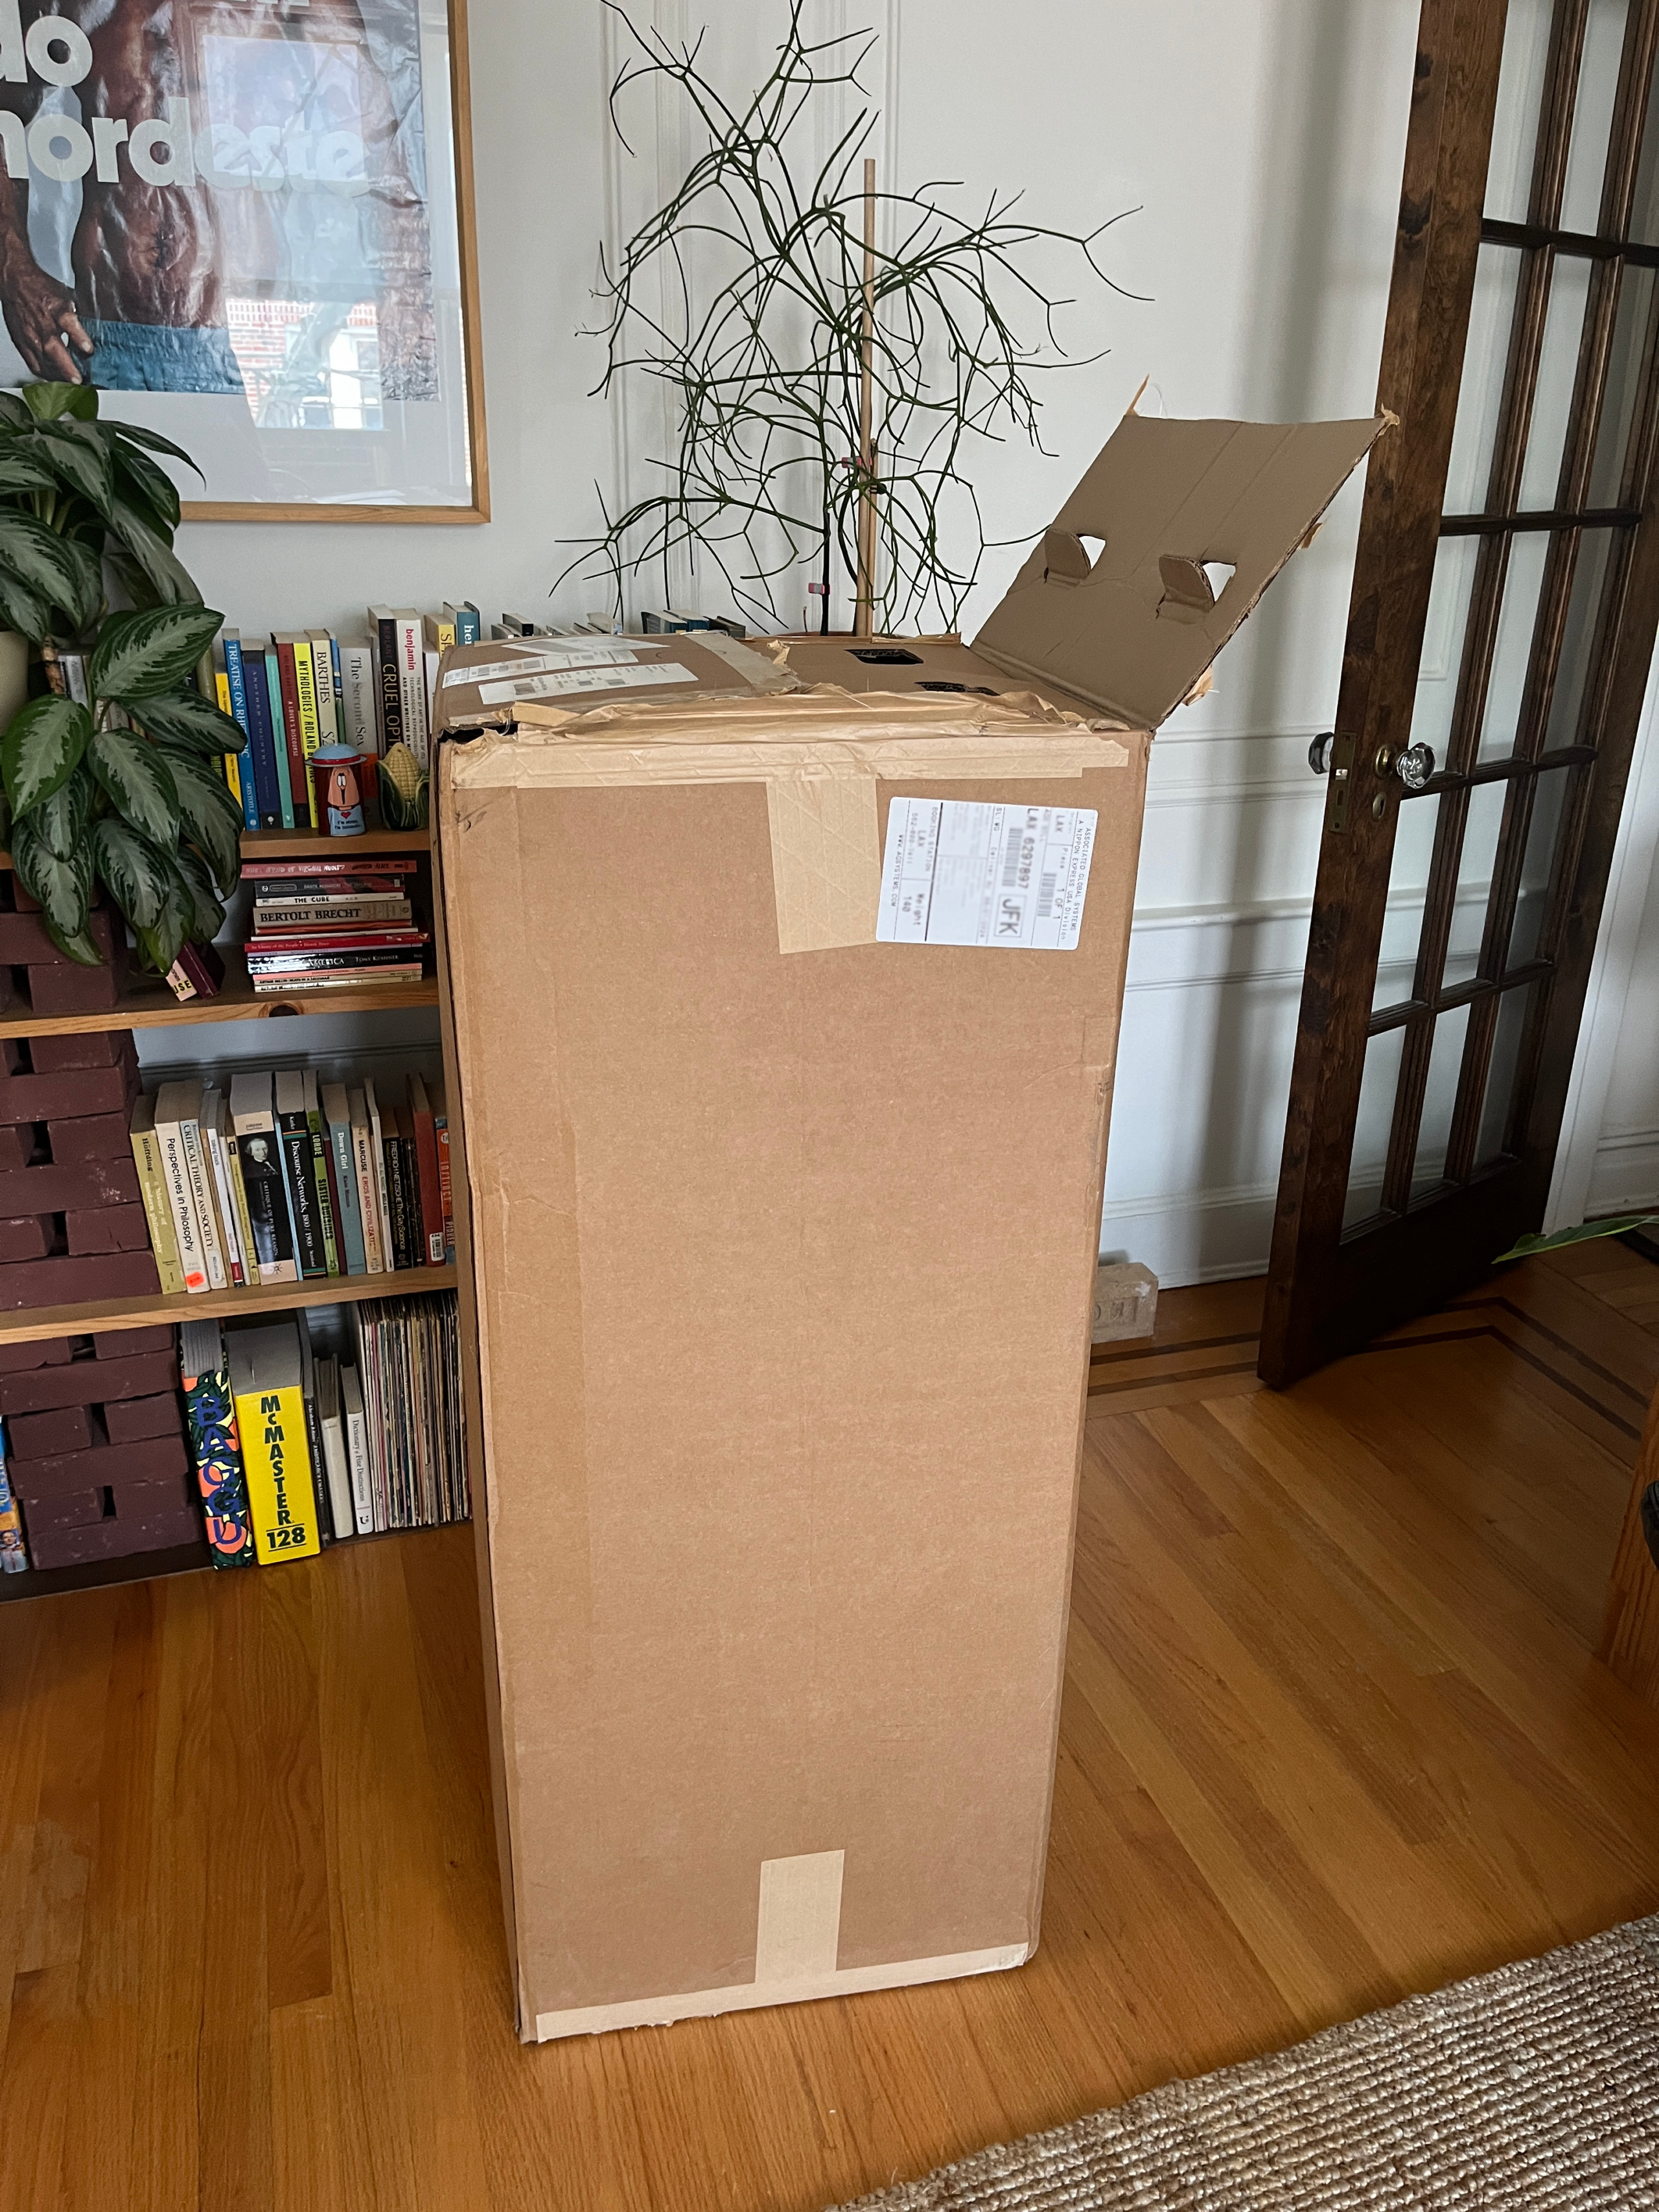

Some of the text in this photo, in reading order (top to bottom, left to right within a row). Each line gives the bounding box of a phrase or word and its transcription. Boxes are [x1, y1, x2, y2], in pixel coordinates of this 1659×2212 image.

[384, 625, 392, 658] BERLANT
[404, 629, 416, 670] benjamin
[297, 660, 312, 712] MYTHOLOGIES
[317, 651, 330, 703] BARTHES
[382, 663, 399, 710] CRUEL
[252, 671, 266, 766] ANOTHER COUNTRY
[350, 657, 367, 746] The Second Sex
[227, 643, 255, 813] TREATISE ON ARISTOTLE
[304, 721, 316, 749] ROLAND
[916, 830, 926, 847] LAX
[925, 807, 938, 871] BOOKING STATION
[993, 822, 1000, 831] WG
[1054, 815, 1064, 832] LAX
[1017, 808, 1039, 889] LAX 6297897
[1058, 847, 1068, 868] Piece
[1073, 828, 1082, 854] NIPPON
[1069, 857, 1078, 887] EXPRESS
[1070, 828, 1091, 931] ASSOCIATED GLOBAL SYSTEMS
[260, 907, 361, 922] BERTOLT BRECHT
[901, 896, 912, 913] 140
[911, 892, 925, 926] Weight
[998, 898, 1021, 935] JFK
[1054, 898, 1063, 909] OF
[1060, 907, 1071, 940] Division
[142, 1137, 154, 1172] Höffding
[291, 1141, 303, 1175] Discourse
[312, 1134, 321, 1155] LORDE
[340, 1154, 348, 1169] Girl
[358, 1139, 367, 1172] MARCUSE
[390, 1141, 399, 1170] FRIEDRICH
[165, 1137, 195, 1253] Perspectives in Philosophy
[183, 1124, 198, 1163] CRITICAL
[191, 1165, 204, 1198] THEORY
[200, 1213, 214, 1247] SOCIETY
[296, 1176, 309, 1213] Networks,
[145, 1182, 163, 1253] modern philosophy
[154, 1187, 165, 1215] history
[160, 1217, 167, 1225] of
[317, 1178, 334, 1240] SISTER OUTSIDER
[395, 1214, 404, 1226] Gay
[398, 1226, 406, 1250] Science
[350, 1419, 361, 1449] Dictionary
[196, 1396, 242, 1544] BAGGU
[355, 1455, 364, 1467] Fine
[356, 1467, 366, 1501] Distinctions
[266, 1526, 306, 1548] 128
